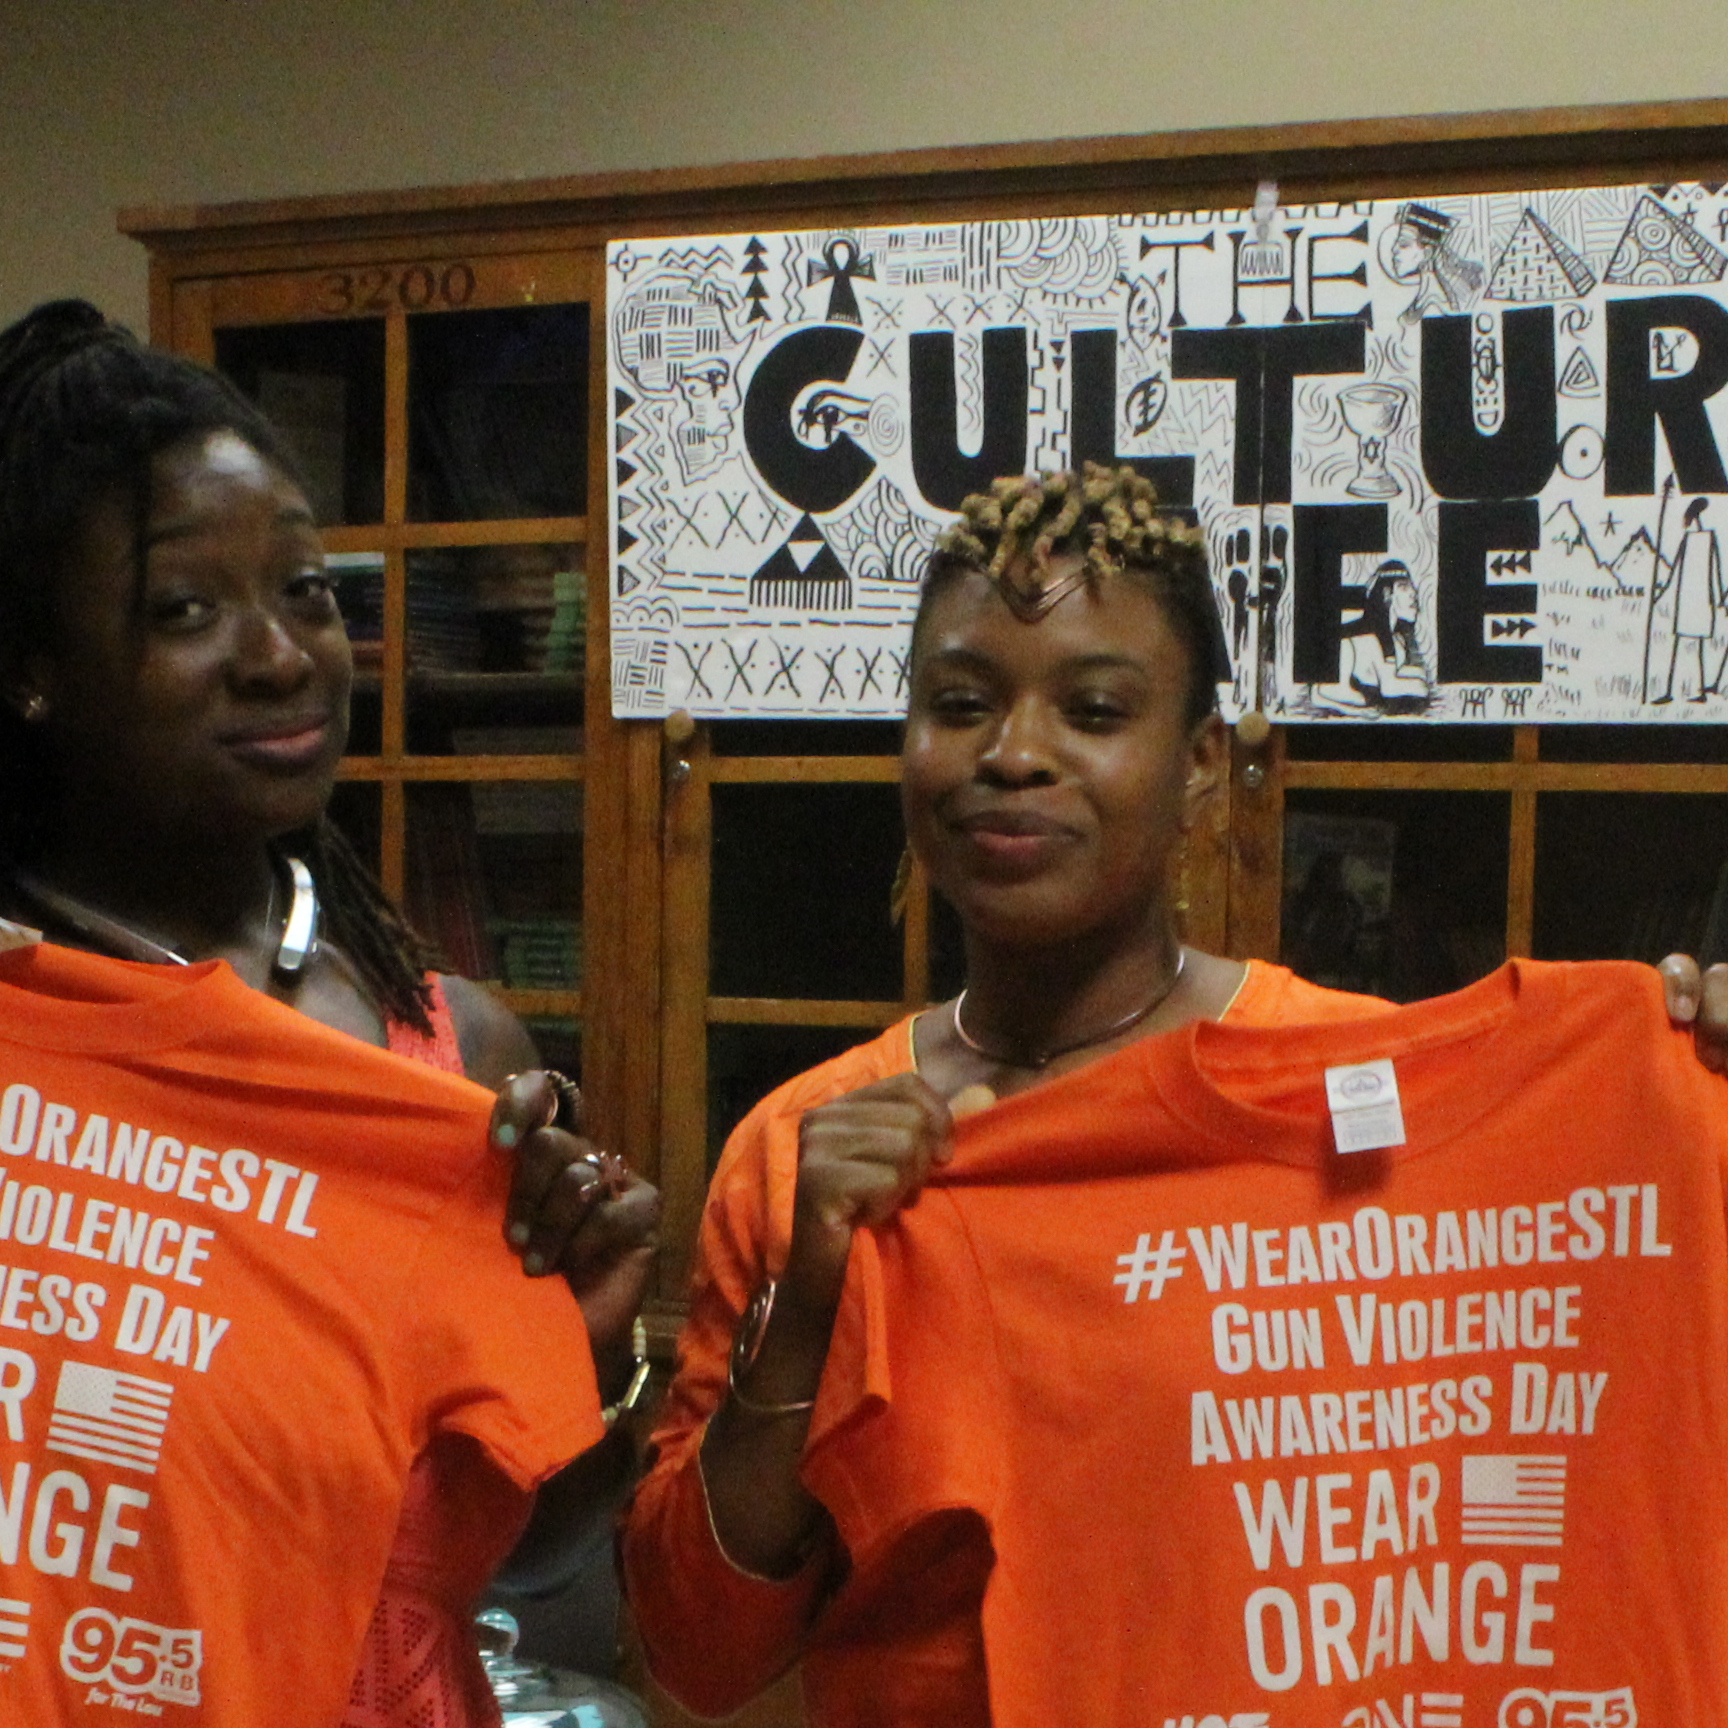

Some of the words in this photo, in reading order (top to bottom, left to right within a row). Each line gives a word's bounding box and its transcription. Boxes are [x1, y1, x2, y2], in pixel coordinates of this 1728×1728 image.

[319, 263, 475, 315] 3200
[1140, 226, 1371, 328] THE
[1112, 1183, 1672, 1303] #WEARORANGESTL
[115, 1284, 230, 1373] DAY
[1210, 1302, 1325, 1374] GUN
[1335, 1286, 1582, 1367] VIOLENCE
[1190, 1375, 1493, 1467] AWARENESS
[1509, 1361, 1609, 1436] DAY
[1232, 1462, 1442, 1571] WEAR
[66, 1614, 196, 1687] 95.5
[1243, 1560, 1561, 1692] ORANGE
